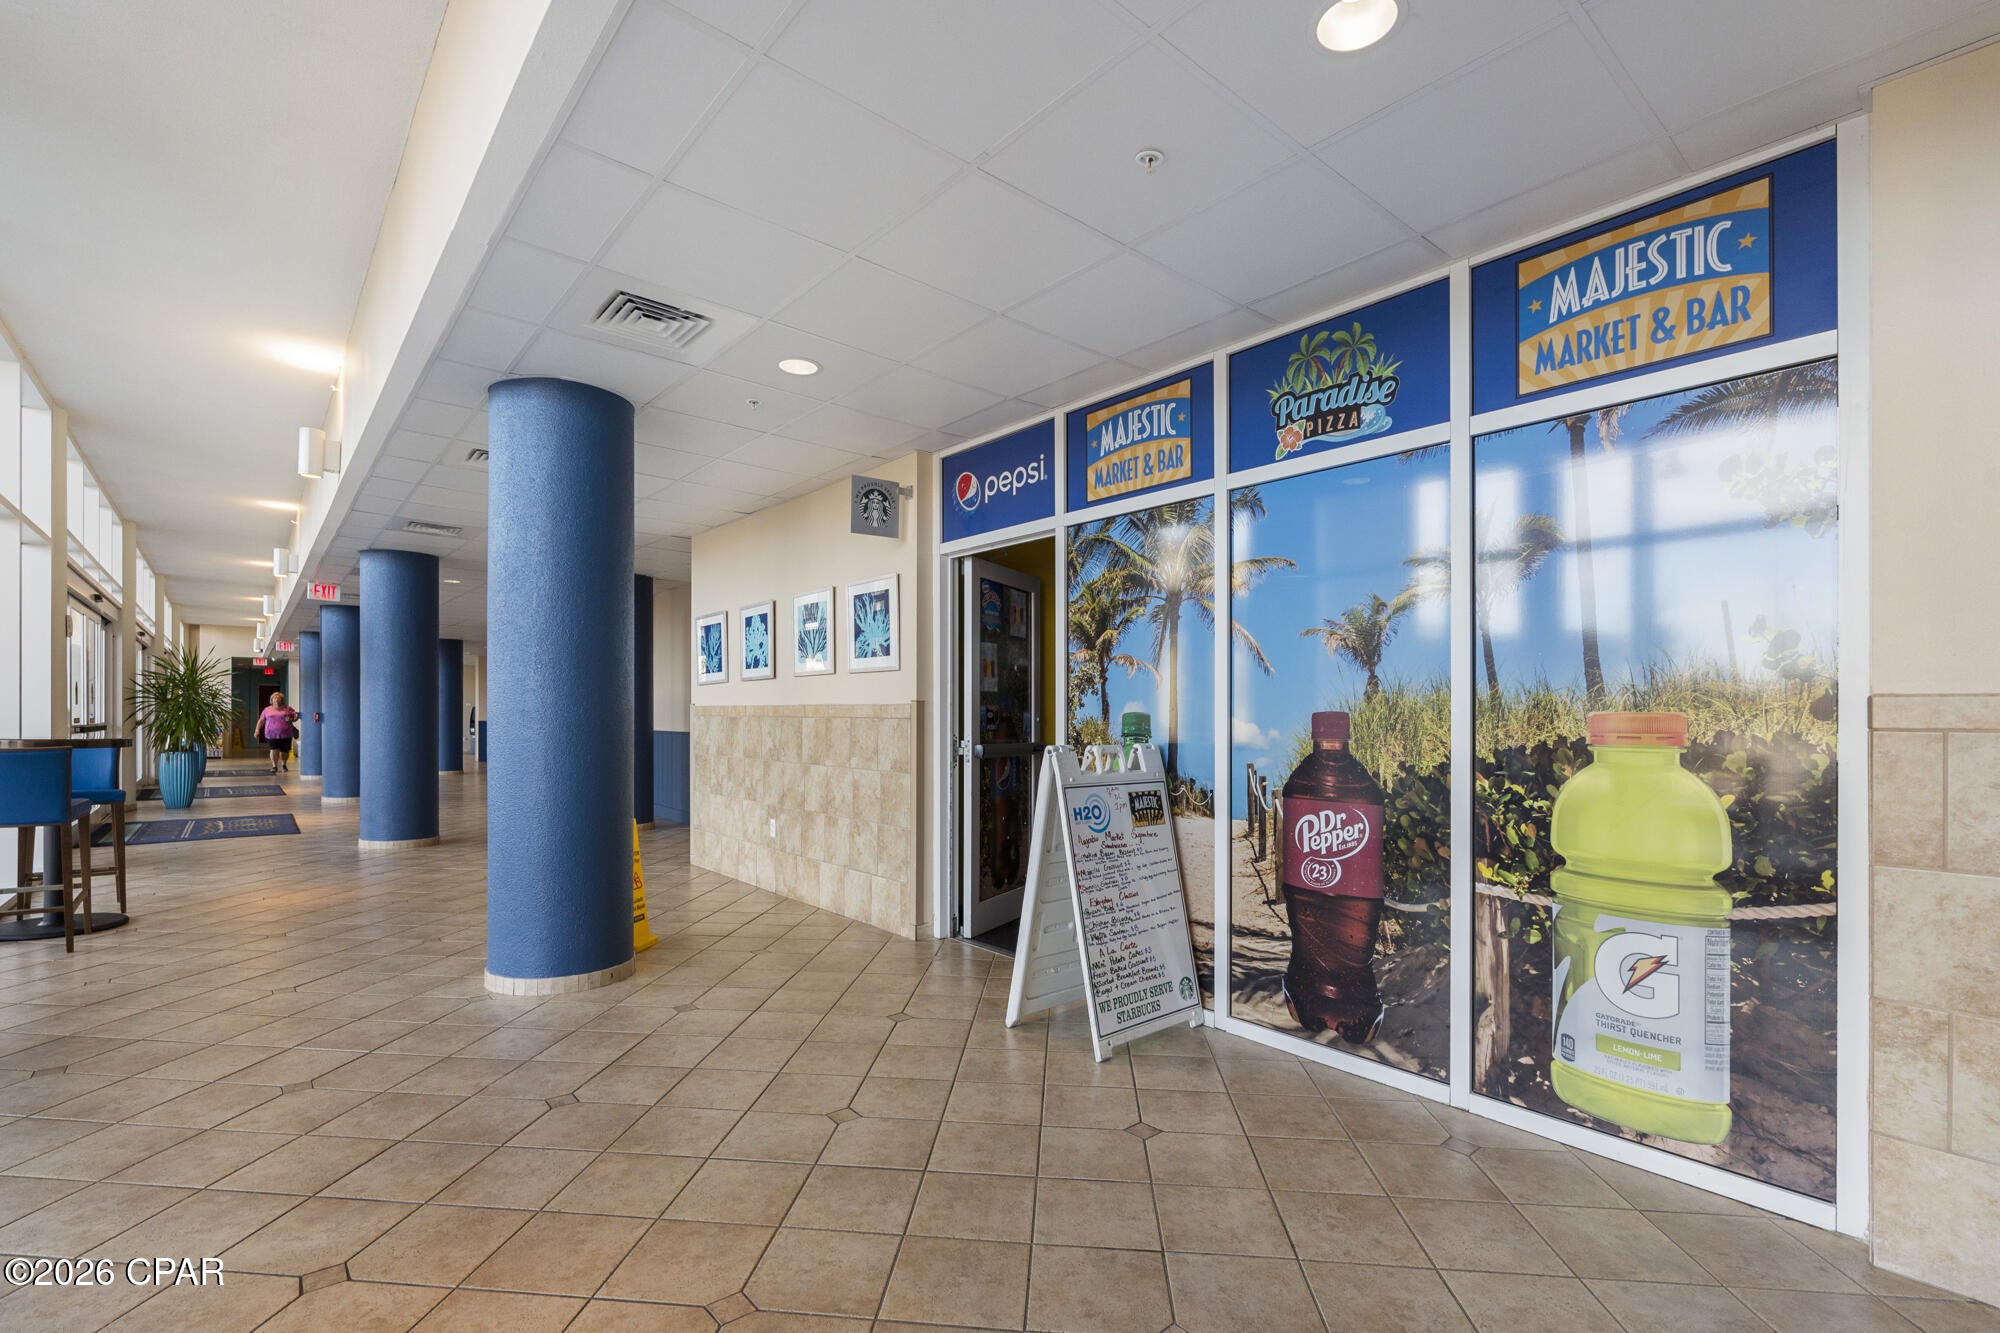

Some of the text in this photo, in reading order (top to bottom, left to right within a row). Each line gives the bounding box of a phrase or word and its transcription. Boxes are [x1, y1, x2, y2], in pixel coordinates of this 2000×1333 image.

[1548, 220, 1733, 324] MAJESTIC
[1535, 284, 1752, 376] MARKET & BAR
[1274, 374, 1397, 427] Paradise
[1099, 402, 1177, 457] MAJESTIC
[1305, 411, 1359, 437] PIZZA
[984, 454, 1045, 504] pepsi
[1093, 444, 1184, 490] MARKET & BAR
[313, 583, 337, 600] EXIT
[1073, 805, 1102, 821] H2O
[1134, 795, 1159, 811] MAJESTIC
[1297, 814, 1364, 855] Pepper
[1319, 810, 1347, 833] Dr
[1312, 863, 1328, 880] 23
[1098, 980, 1174, 1014] WE PROUDLY SERVE
[1116, 999, 1162, 1025] STARBUCKS
[1595, 1012, 1636, 1027] GATORADE
[1595, 1019, 1682, 1046] THIRST QUENCHER
[1613, 1043, 1663, 1062] LEMON-LIME
